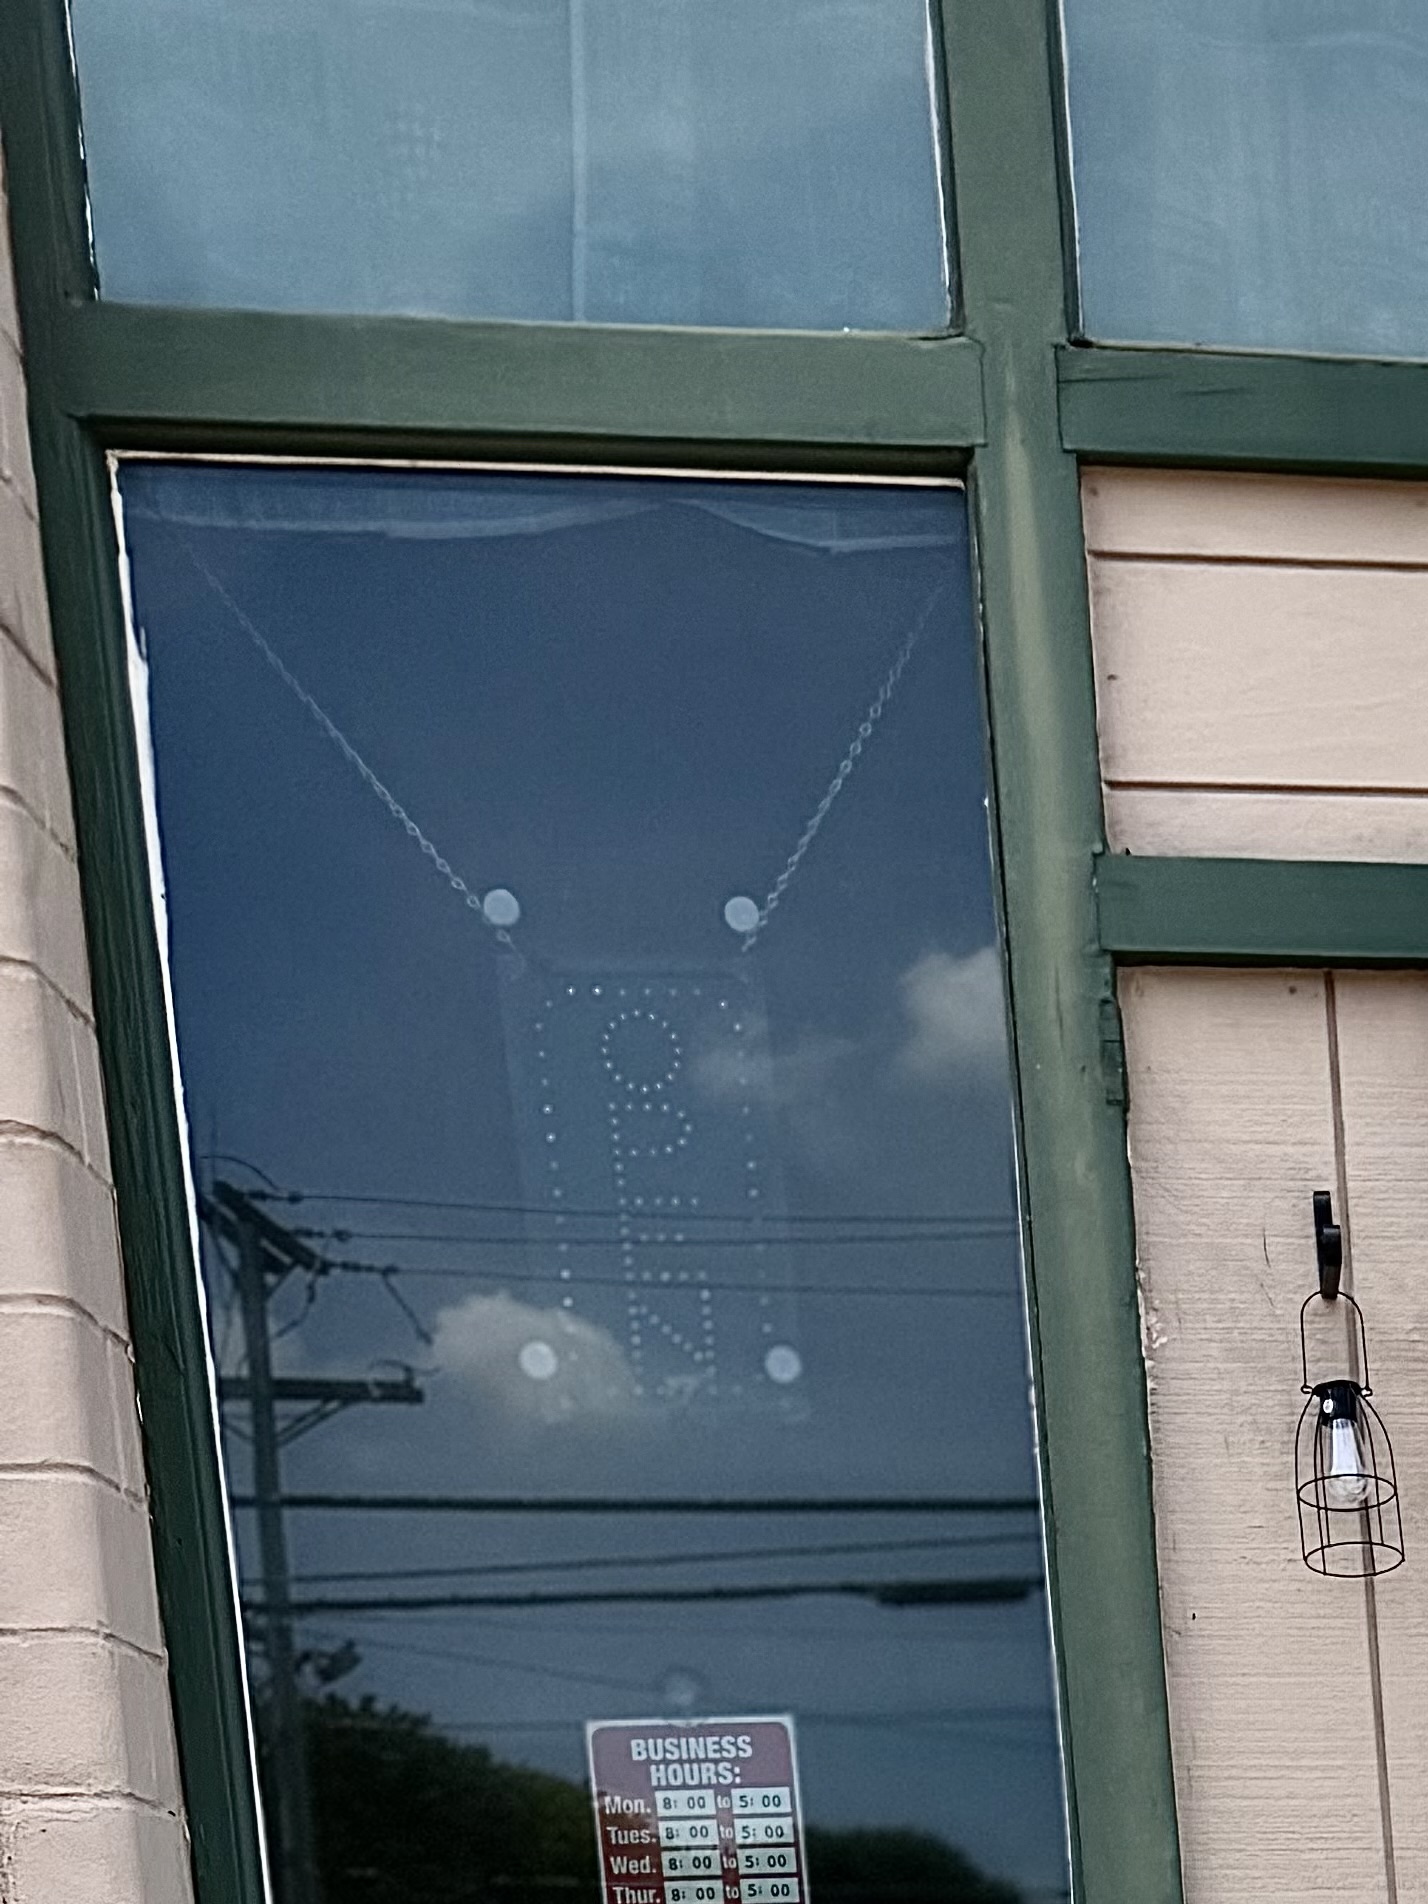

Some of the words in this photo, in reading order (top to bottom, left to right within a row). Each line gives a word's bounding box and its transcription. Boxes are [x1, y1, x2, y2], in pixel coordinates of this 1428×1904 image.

[630, 1736, 752, 1761] BUSINESS
[651, 1763, 741, 1787] HOURS:
[604, 1796, 651, 1815] Mon.
[717, 1795, 731, 1809] to
[606, 1827, 656, 1845] Tues.
[719, 1824, 733, 1839] to
[609, 1855, 656, 1874] Wed.
[723, 1854, 737, 1869] to
[613, 1886, 660, 1904] Thur.
[725, 1885, 739, 1899] to
